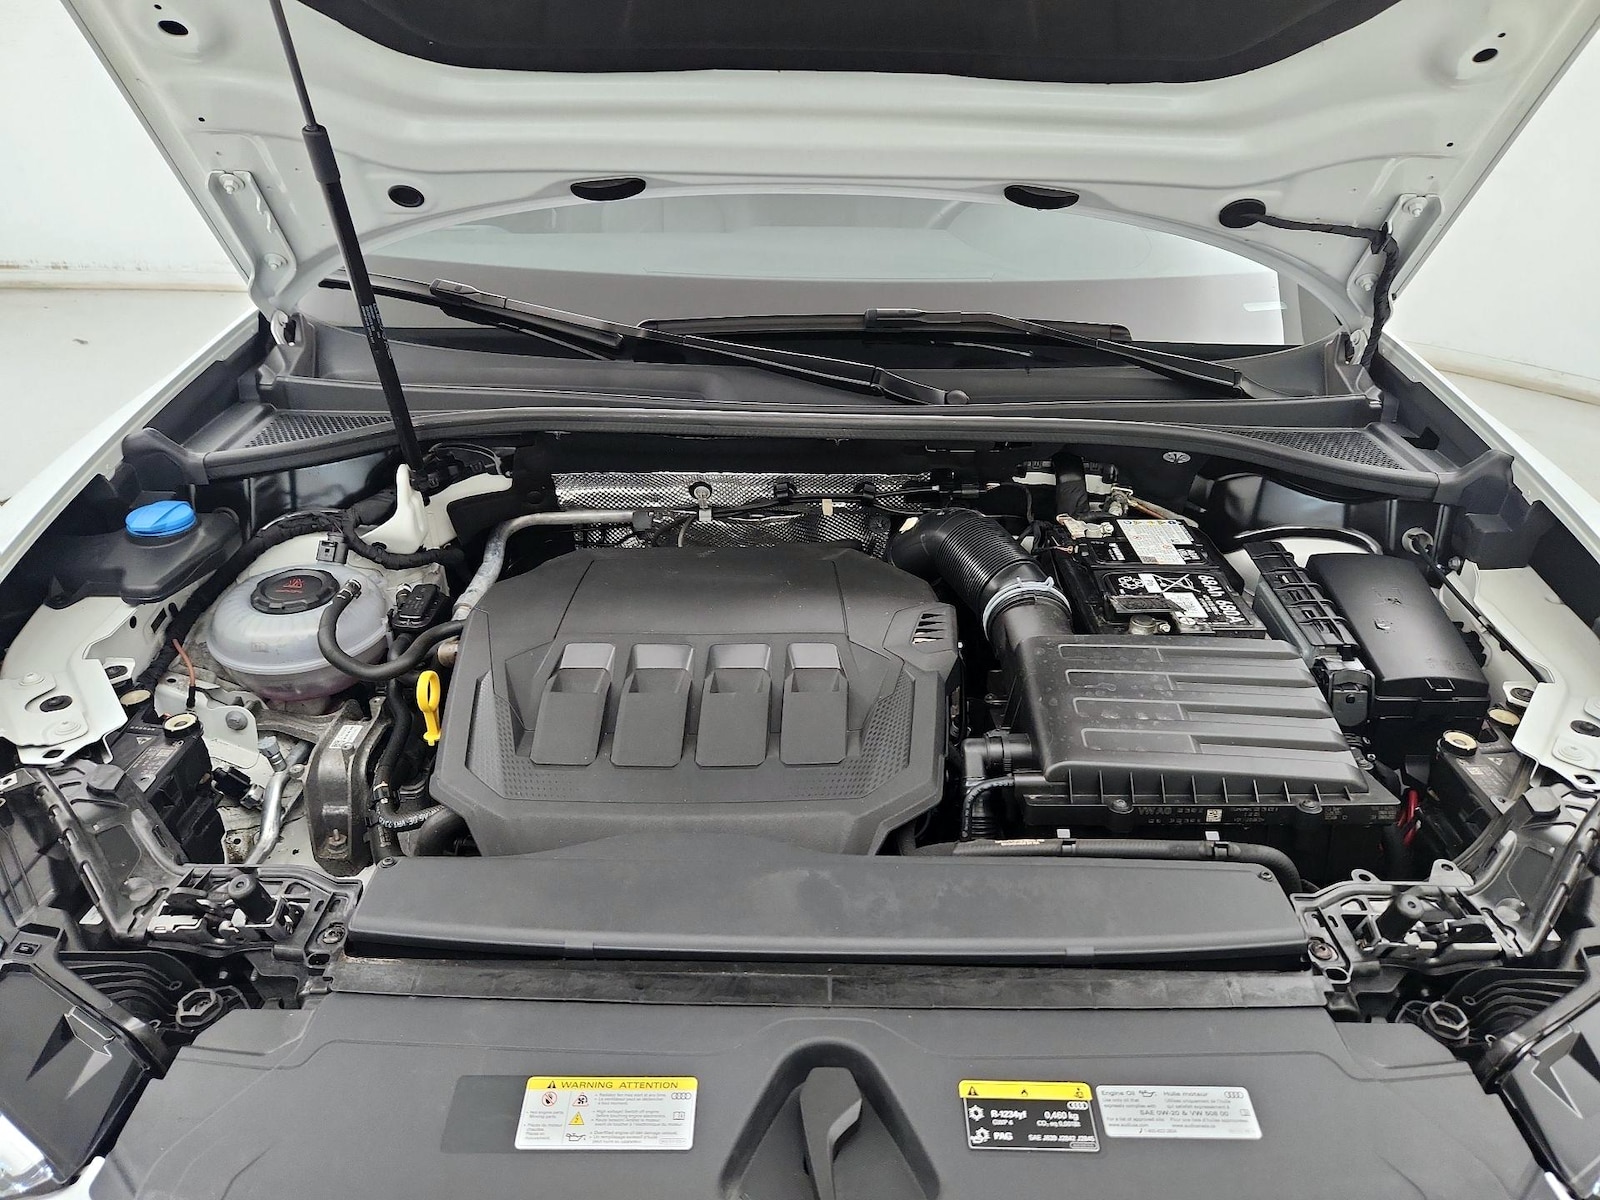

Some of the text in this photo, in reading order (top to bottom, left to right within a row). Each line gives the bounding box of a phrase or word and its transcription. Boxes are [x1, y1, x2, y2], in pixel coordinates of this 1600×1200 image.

[1198, 574, 1225, 597] 68Ah
[1215, 600, 1246, 623] 680A
[561, 1081, 678, 1089] WARNING ATTENTION
[1068, 1112, 1079, 1120] kg
[993, 1132, 1014, 1141] PAG
